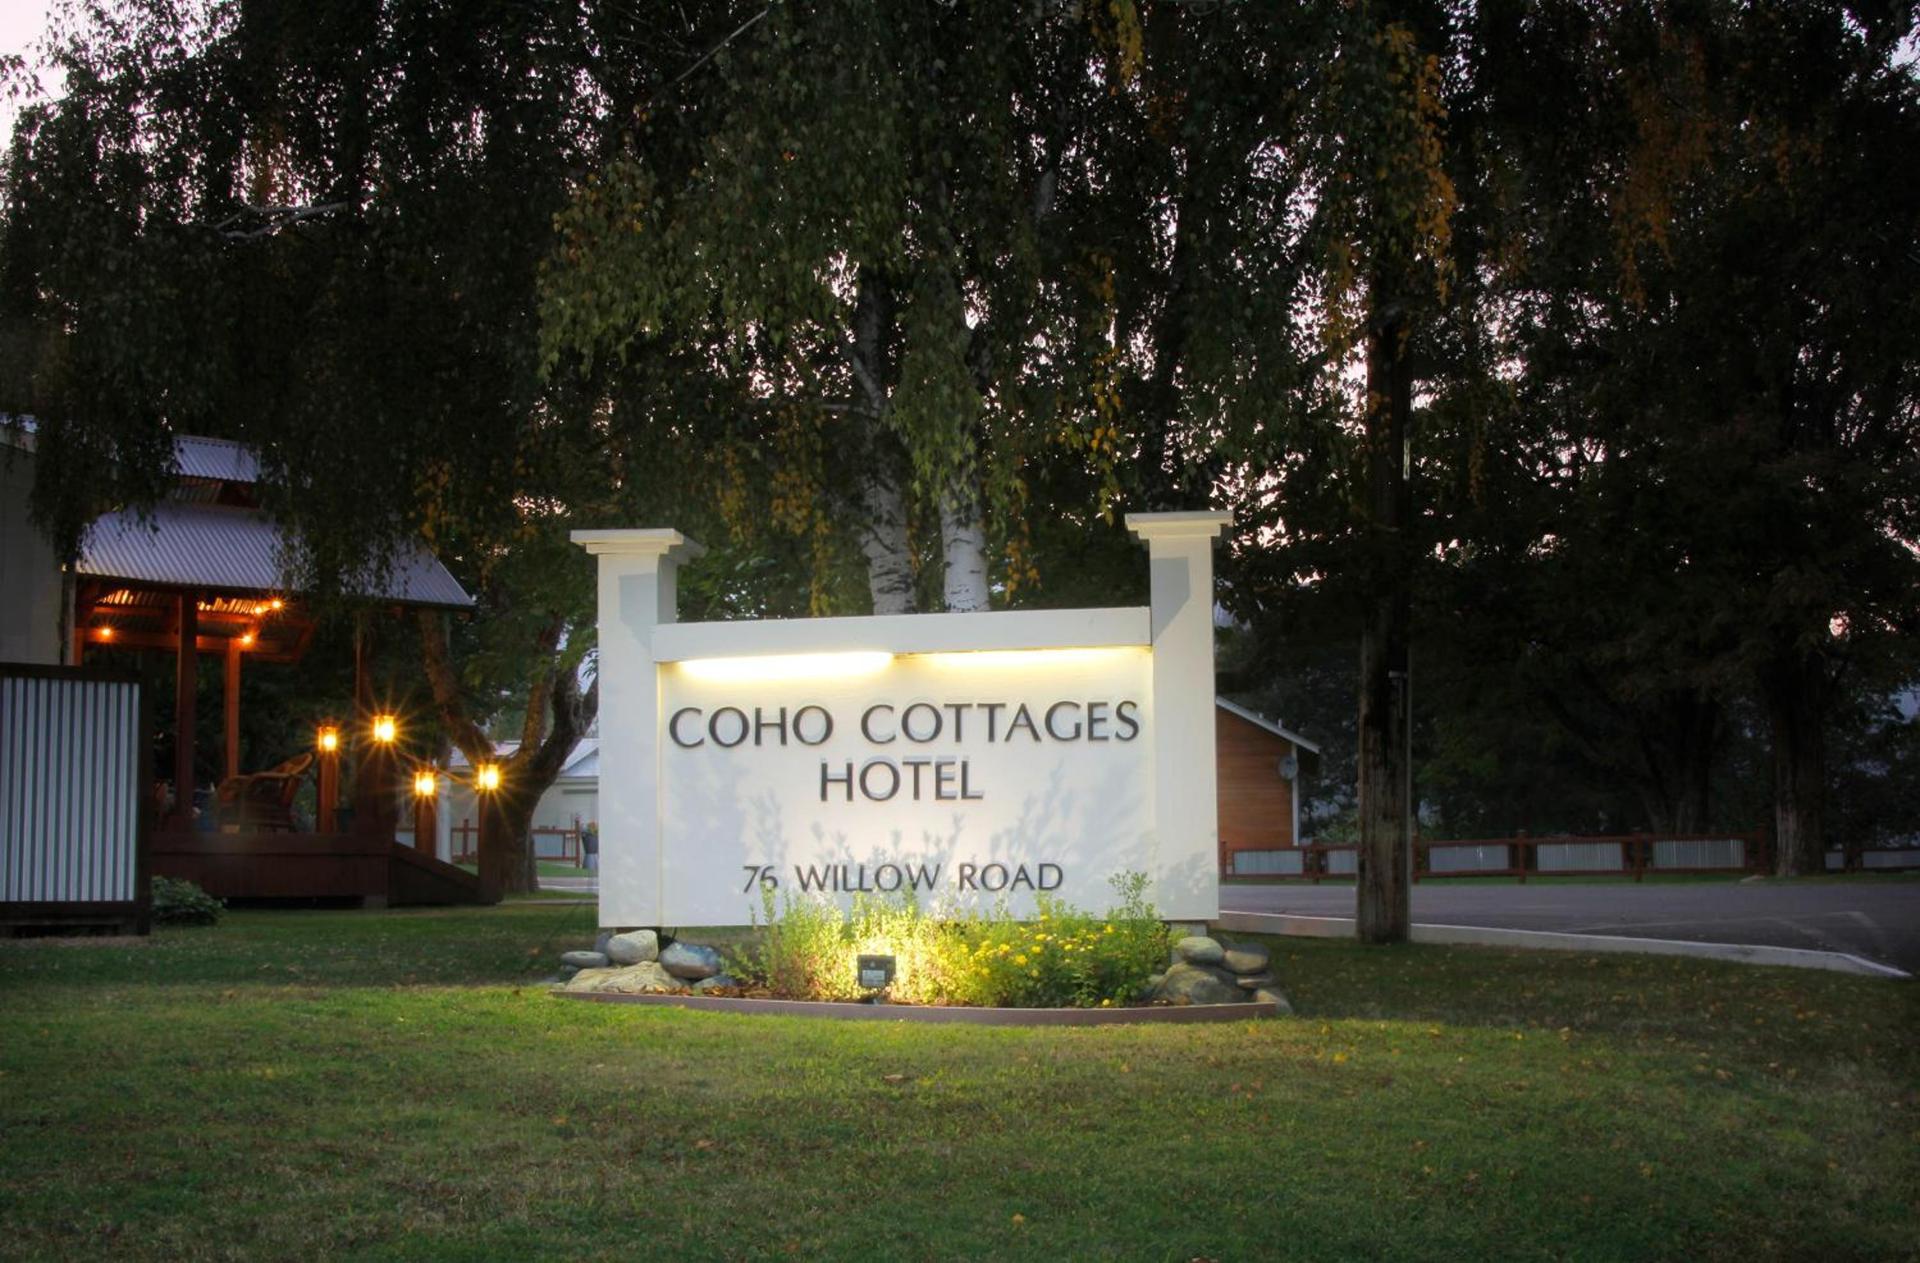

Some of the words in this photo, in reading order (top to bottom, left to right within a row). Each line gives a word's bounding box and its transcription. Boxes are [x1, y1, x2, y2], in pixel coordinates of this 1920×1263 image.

[669, 704, 834, 748] COHO
[860, 700, 1141, 745] COTTAGES
[820, 760, 984, 802] HOTEL
[743, 865, 779, 893] 76
[795, 864, 942, 892] WILLOW
[958, 863, 1064, 892] ROAD
